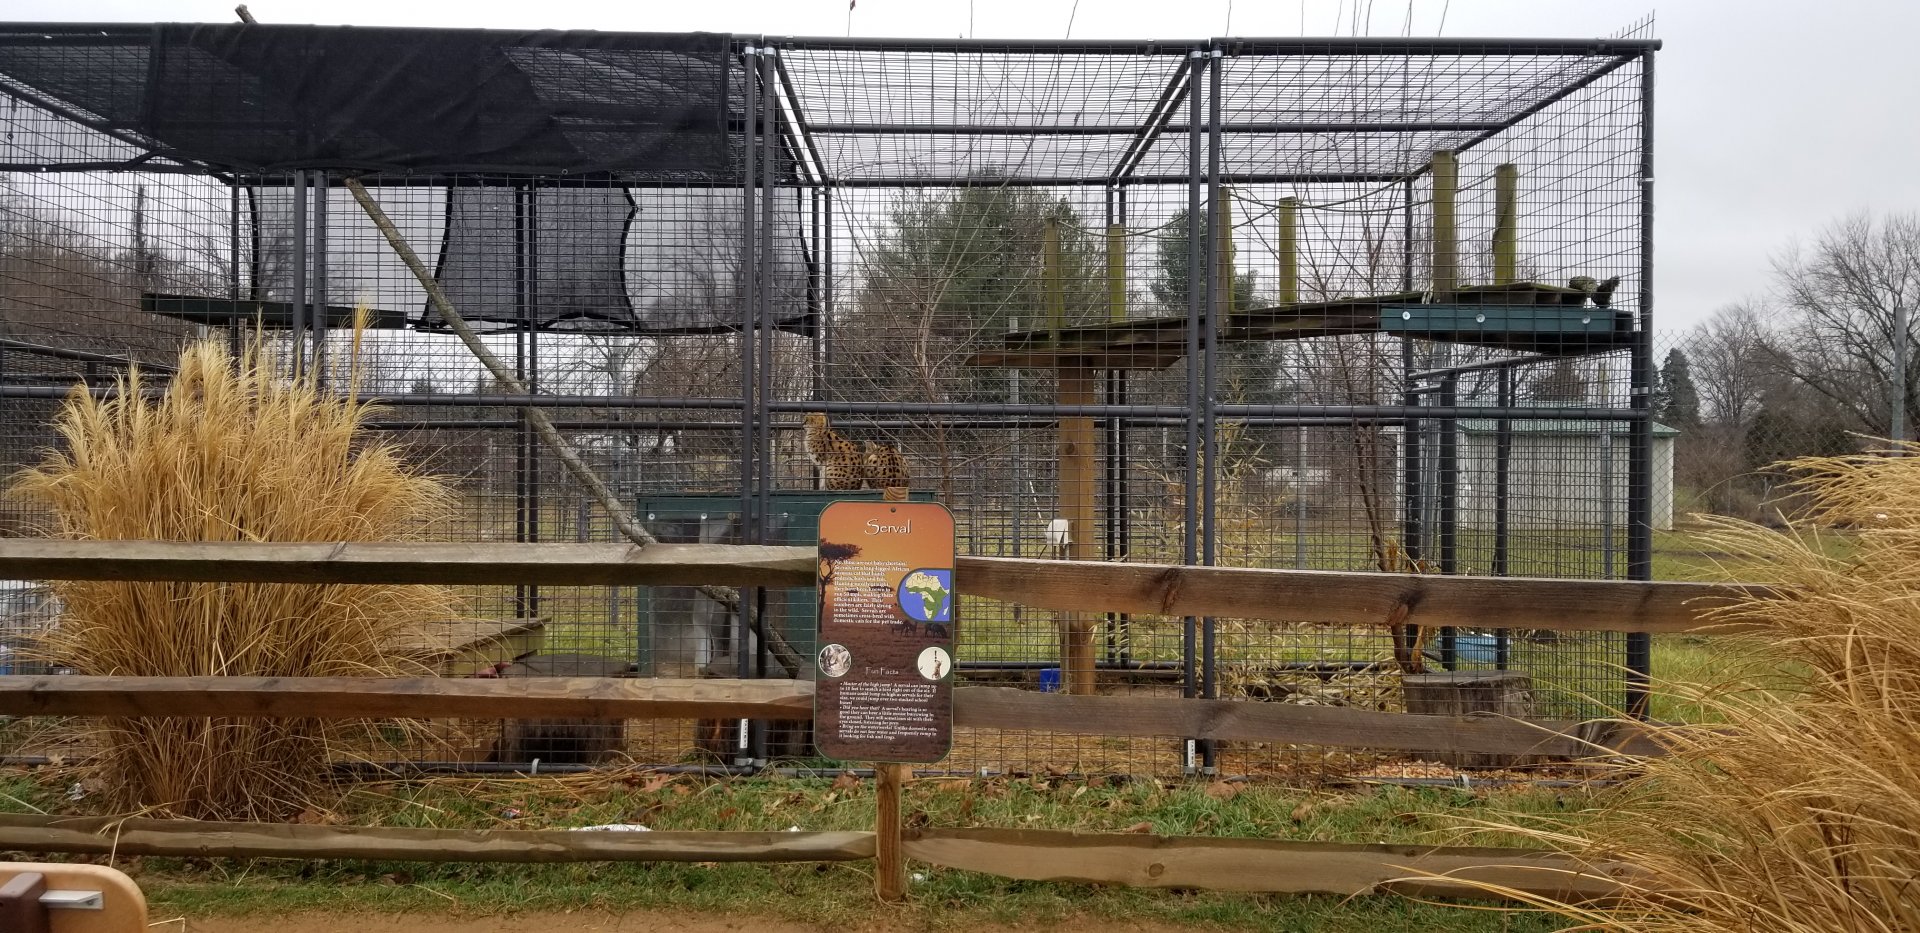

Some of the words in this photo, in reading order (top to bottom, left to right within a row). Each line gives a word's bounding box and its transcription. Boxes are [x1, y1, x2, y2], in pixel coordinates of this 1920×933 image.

[864, 518, 911, 535] Serval
[866, 667, 878, 675] Fun
[881, 667, 899, 675] Facts
